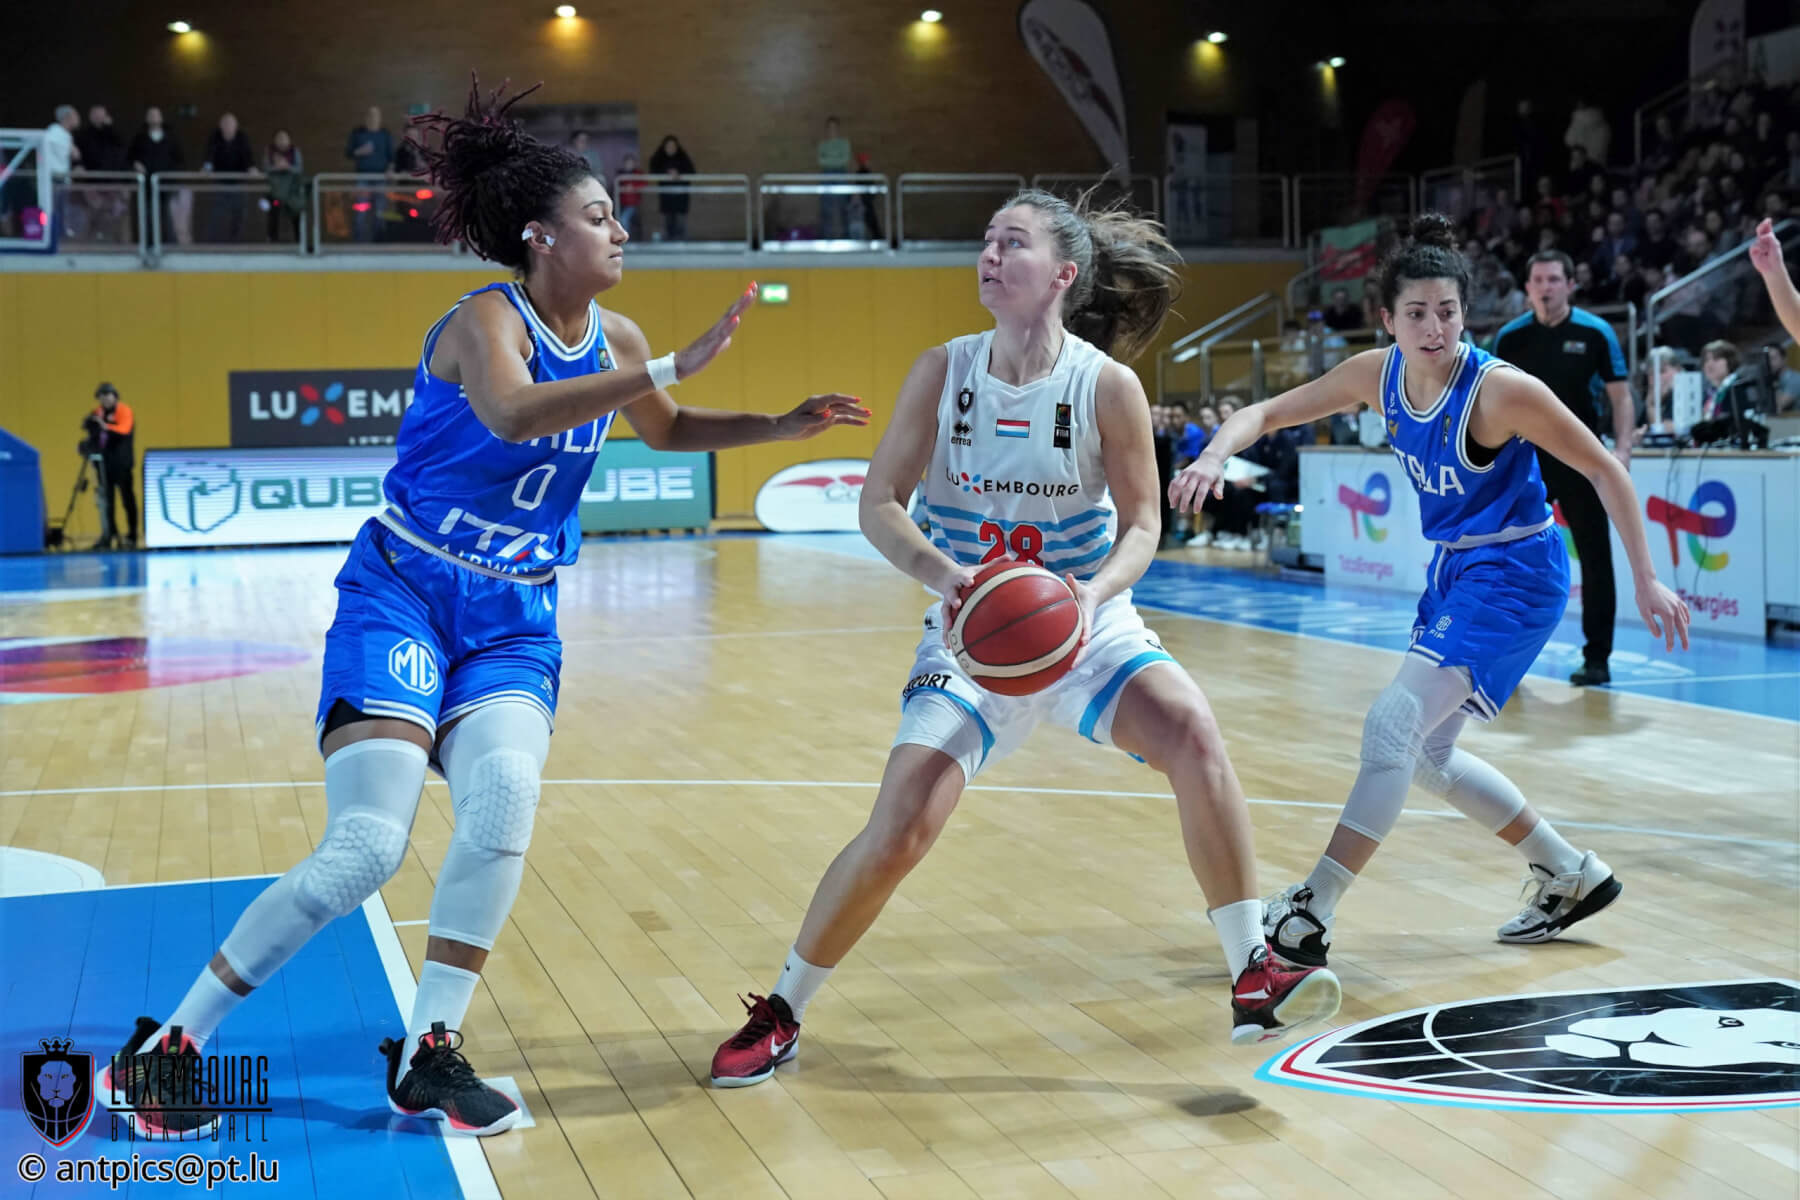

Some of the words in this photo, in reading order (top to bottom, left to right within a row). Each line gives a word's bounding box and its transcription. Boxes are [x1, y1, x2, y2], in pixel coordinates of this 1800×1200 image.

[251, 476, 382, 510] QUB
[512, 464, 557, 511] 0
[580, 466, 694, 502] UBE
[437, 507, 555, 560] ITA
[979, 520, 1045, 570] 28
[392, 642, 436, 692] MG
